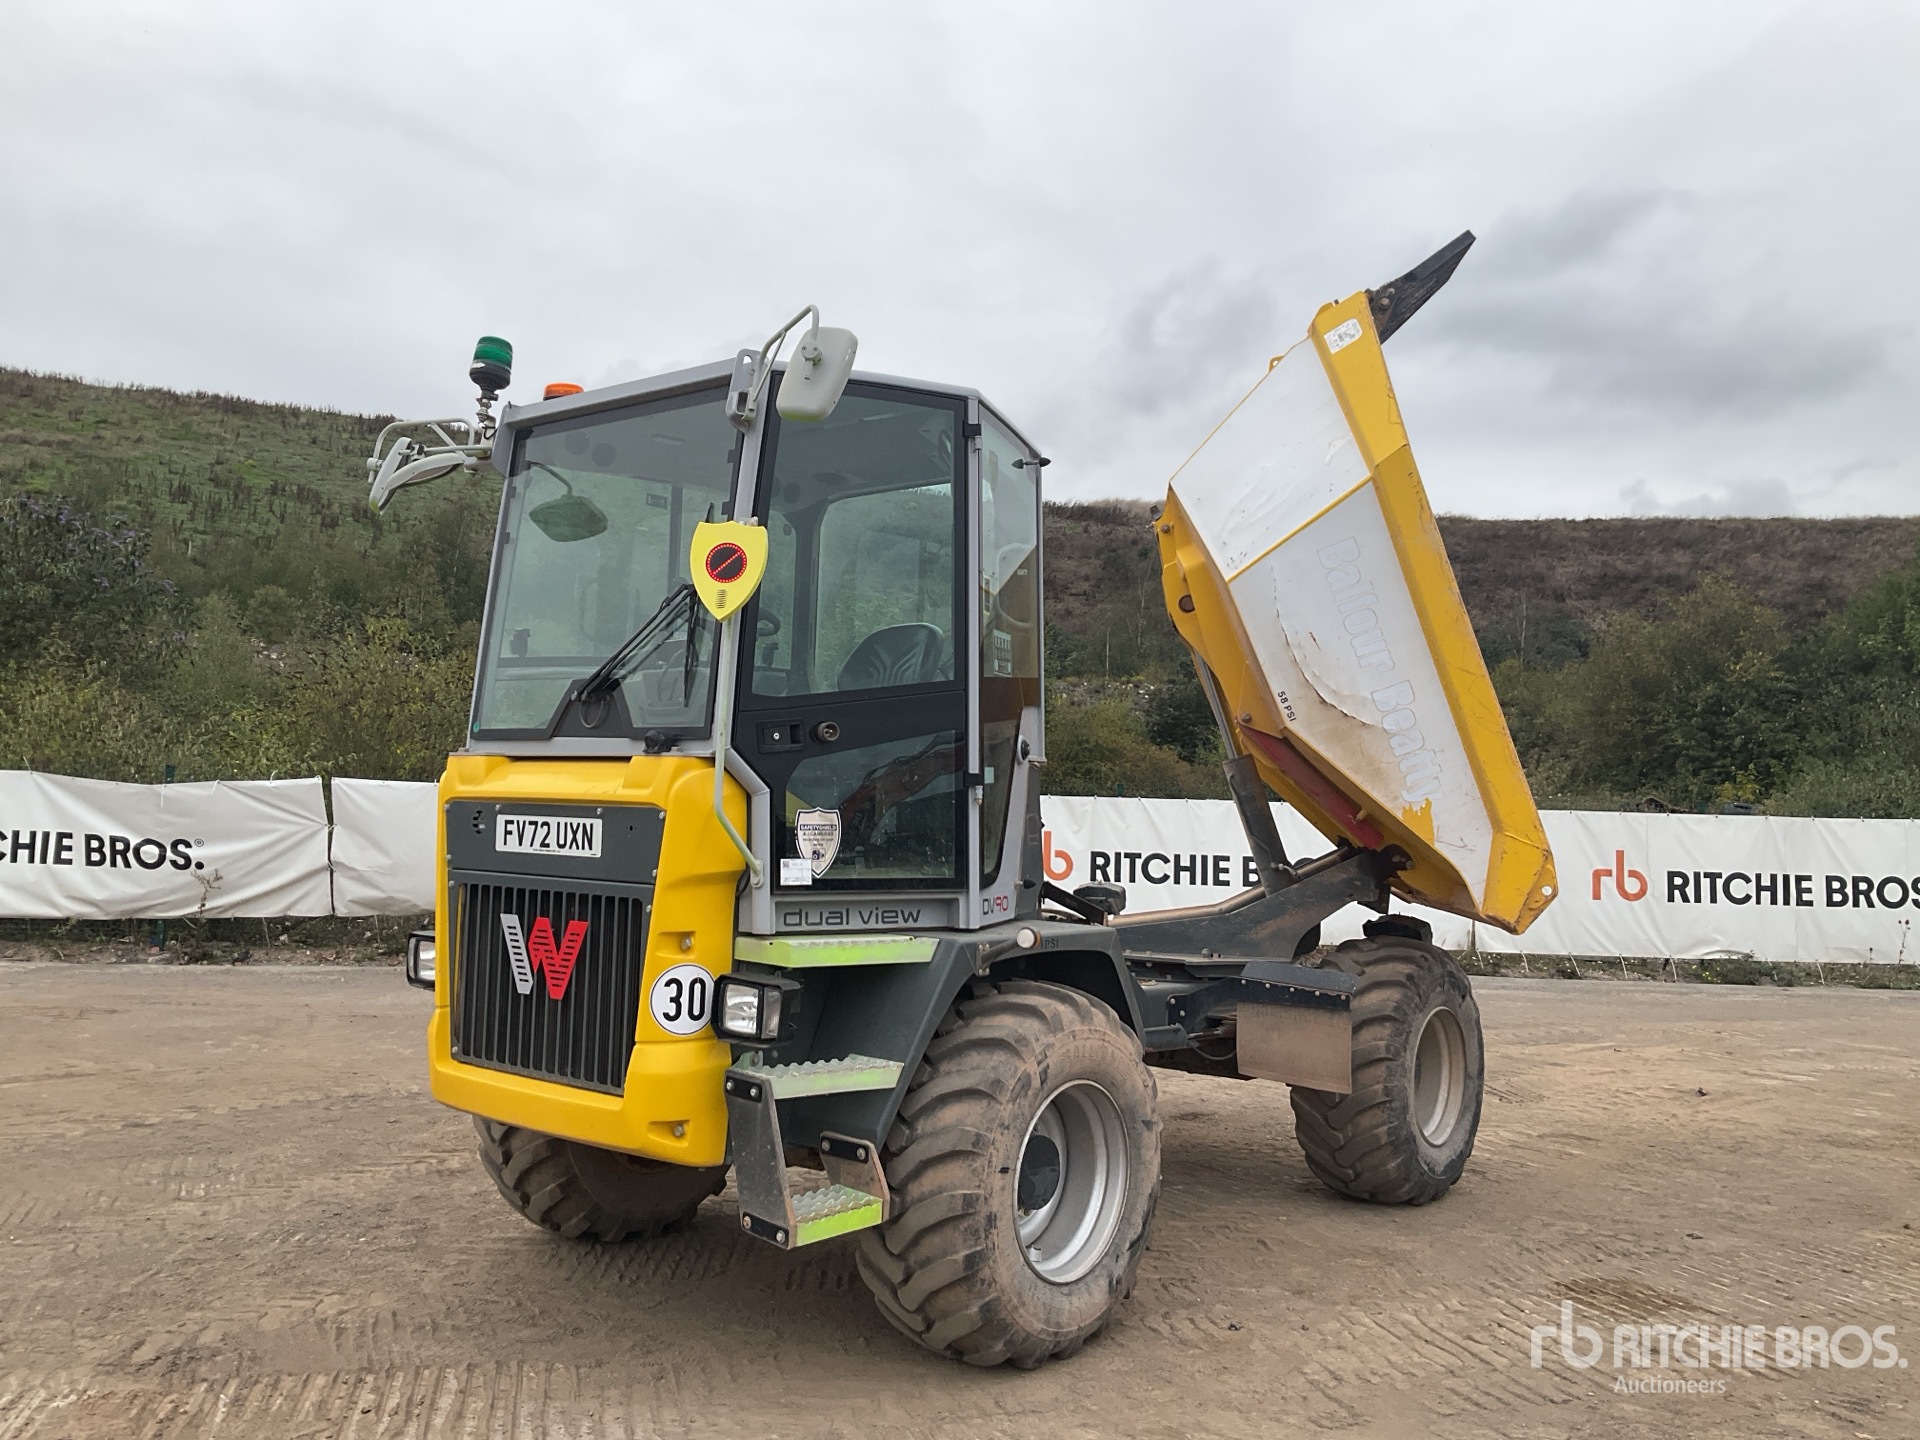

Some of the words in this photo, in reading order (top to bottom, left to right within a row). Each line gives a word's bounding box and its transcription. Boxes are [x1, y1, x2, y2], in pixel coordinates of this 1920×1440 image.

[1278, 691, 1288, 703] 58
[1284, 705, 1296, 721] PSI
[503, 819, 550, 849] FV72
[556, 822, 593, 851] UXN
[1090, 851, 1230, 887] RITCHIE
[1592, 849, 1648, 902] rb
[1667, 870, 1814, 907] RITCHIE
[783, 908, 850, 927] dual
[858, 907, 921, 925] view
[662, 977, 707, 1022] 30
